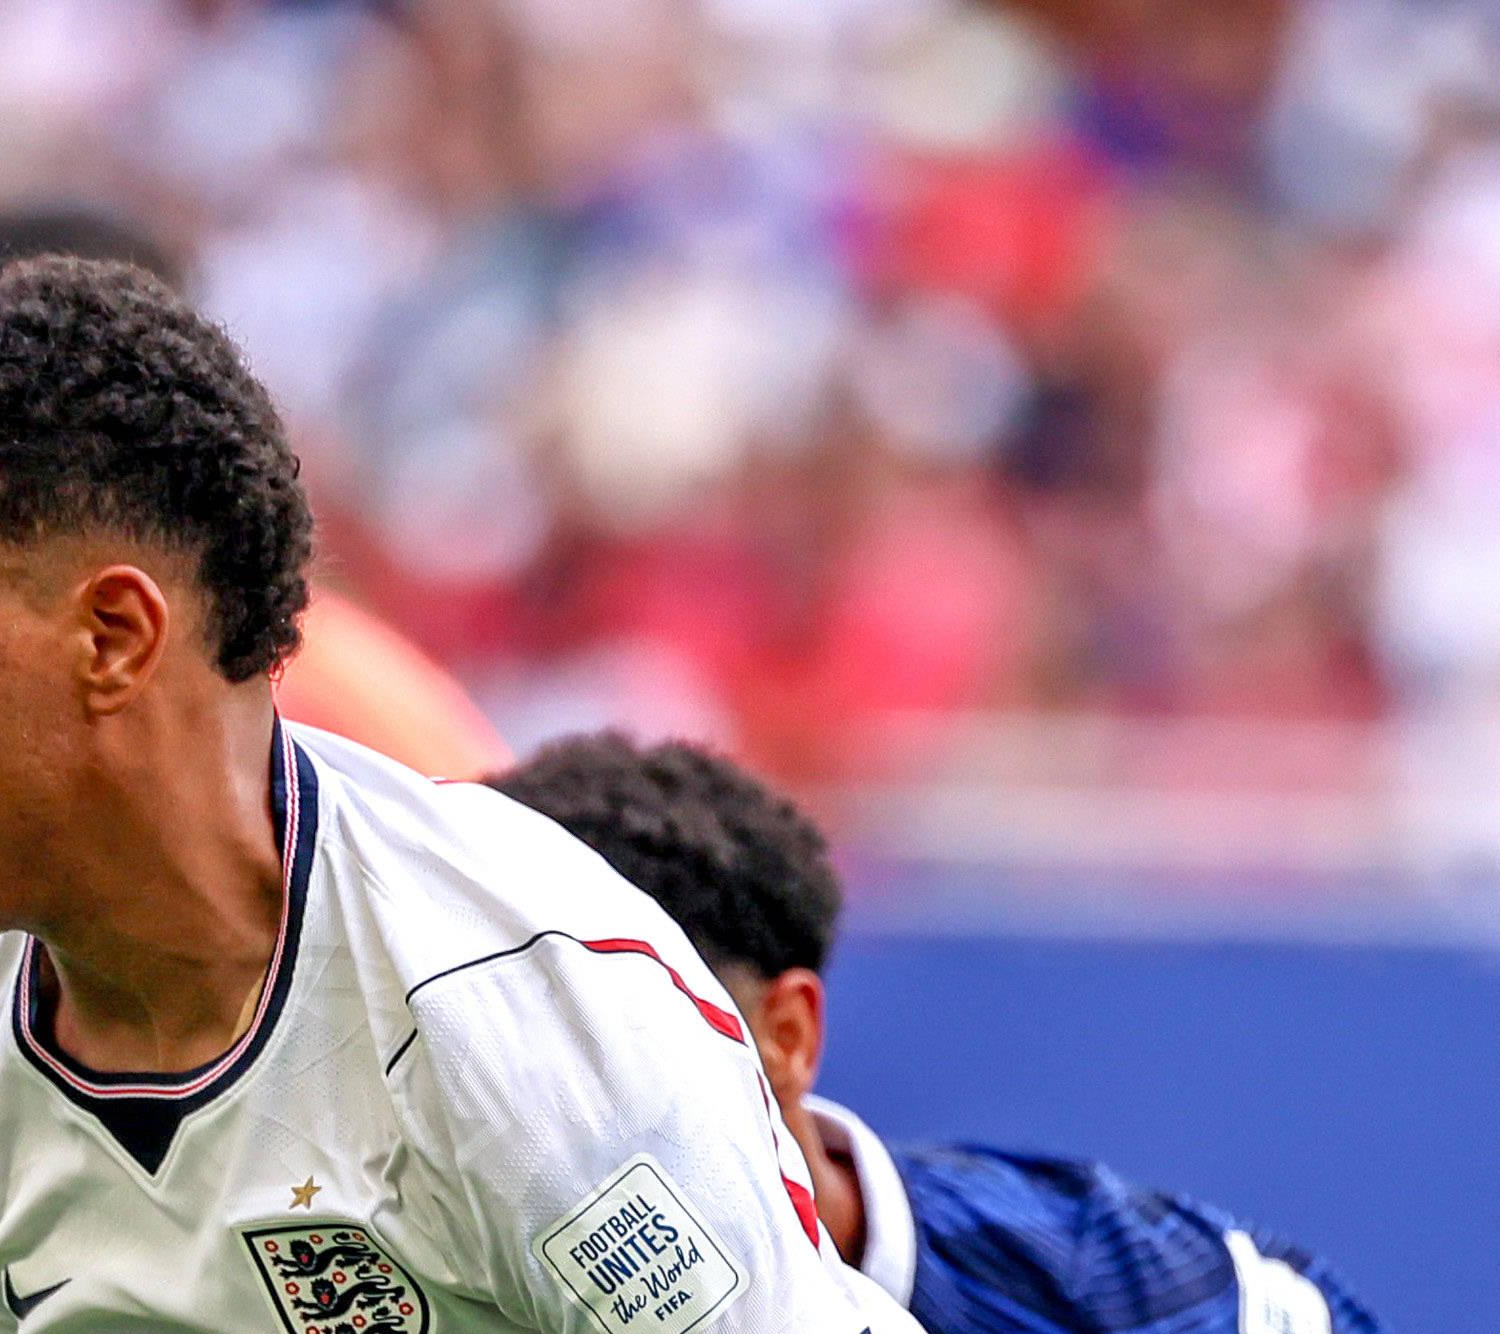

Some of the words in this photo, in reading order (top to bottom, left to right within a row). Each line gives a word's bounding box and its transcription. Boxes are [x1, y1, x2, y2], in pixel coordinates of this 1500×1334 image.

[569, 1194, 656, 1269] FOOTBALL
[587, 1213, 679, 1295] UNITES
[611, 1294, 647, 1324] the
[640, 1236, 705, 1299] World
[654, 1290, 692, 1321] FIFA
